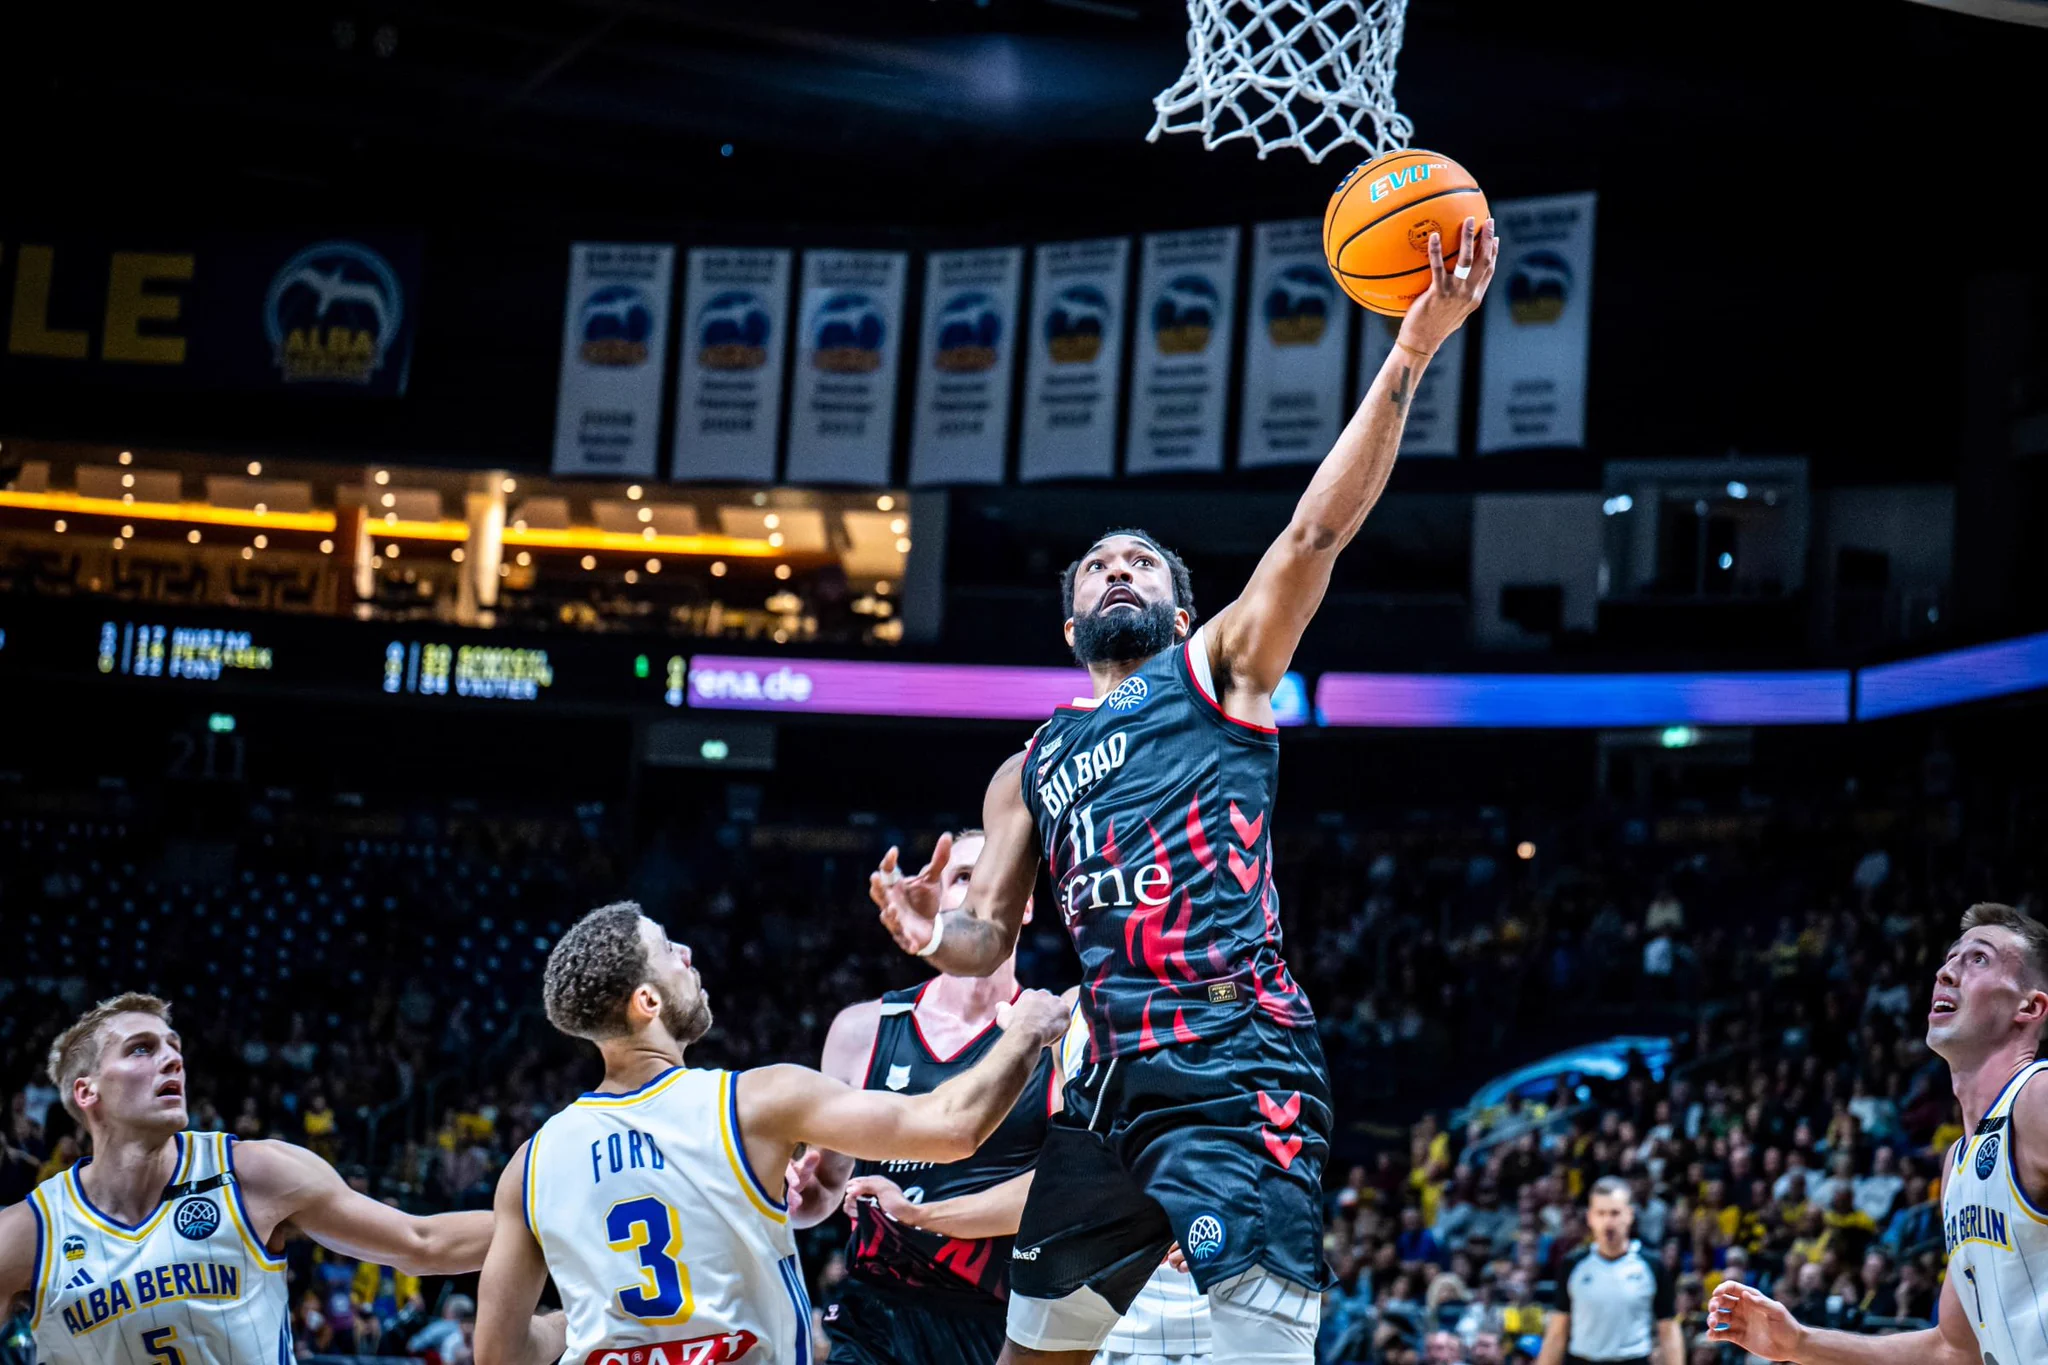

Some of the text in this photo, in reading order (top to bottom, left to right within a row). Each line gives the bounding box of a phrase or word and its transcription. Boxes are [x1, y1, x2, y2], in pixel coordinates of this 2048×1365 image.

[0, 243, 195, 365] LE
[1037, 732, 1127, 820] BILBAO
[1060, 863, 1171, 926] rne
[591, 1129, 665, 1184] FORD
[603, 1193, 696, 1327] 3
[1959, 1204, 2012, 1250] BERLIN
[62, 1262, 241, 1337] ALBA BERLIN
[141, 1325, 187, 1365] 5
